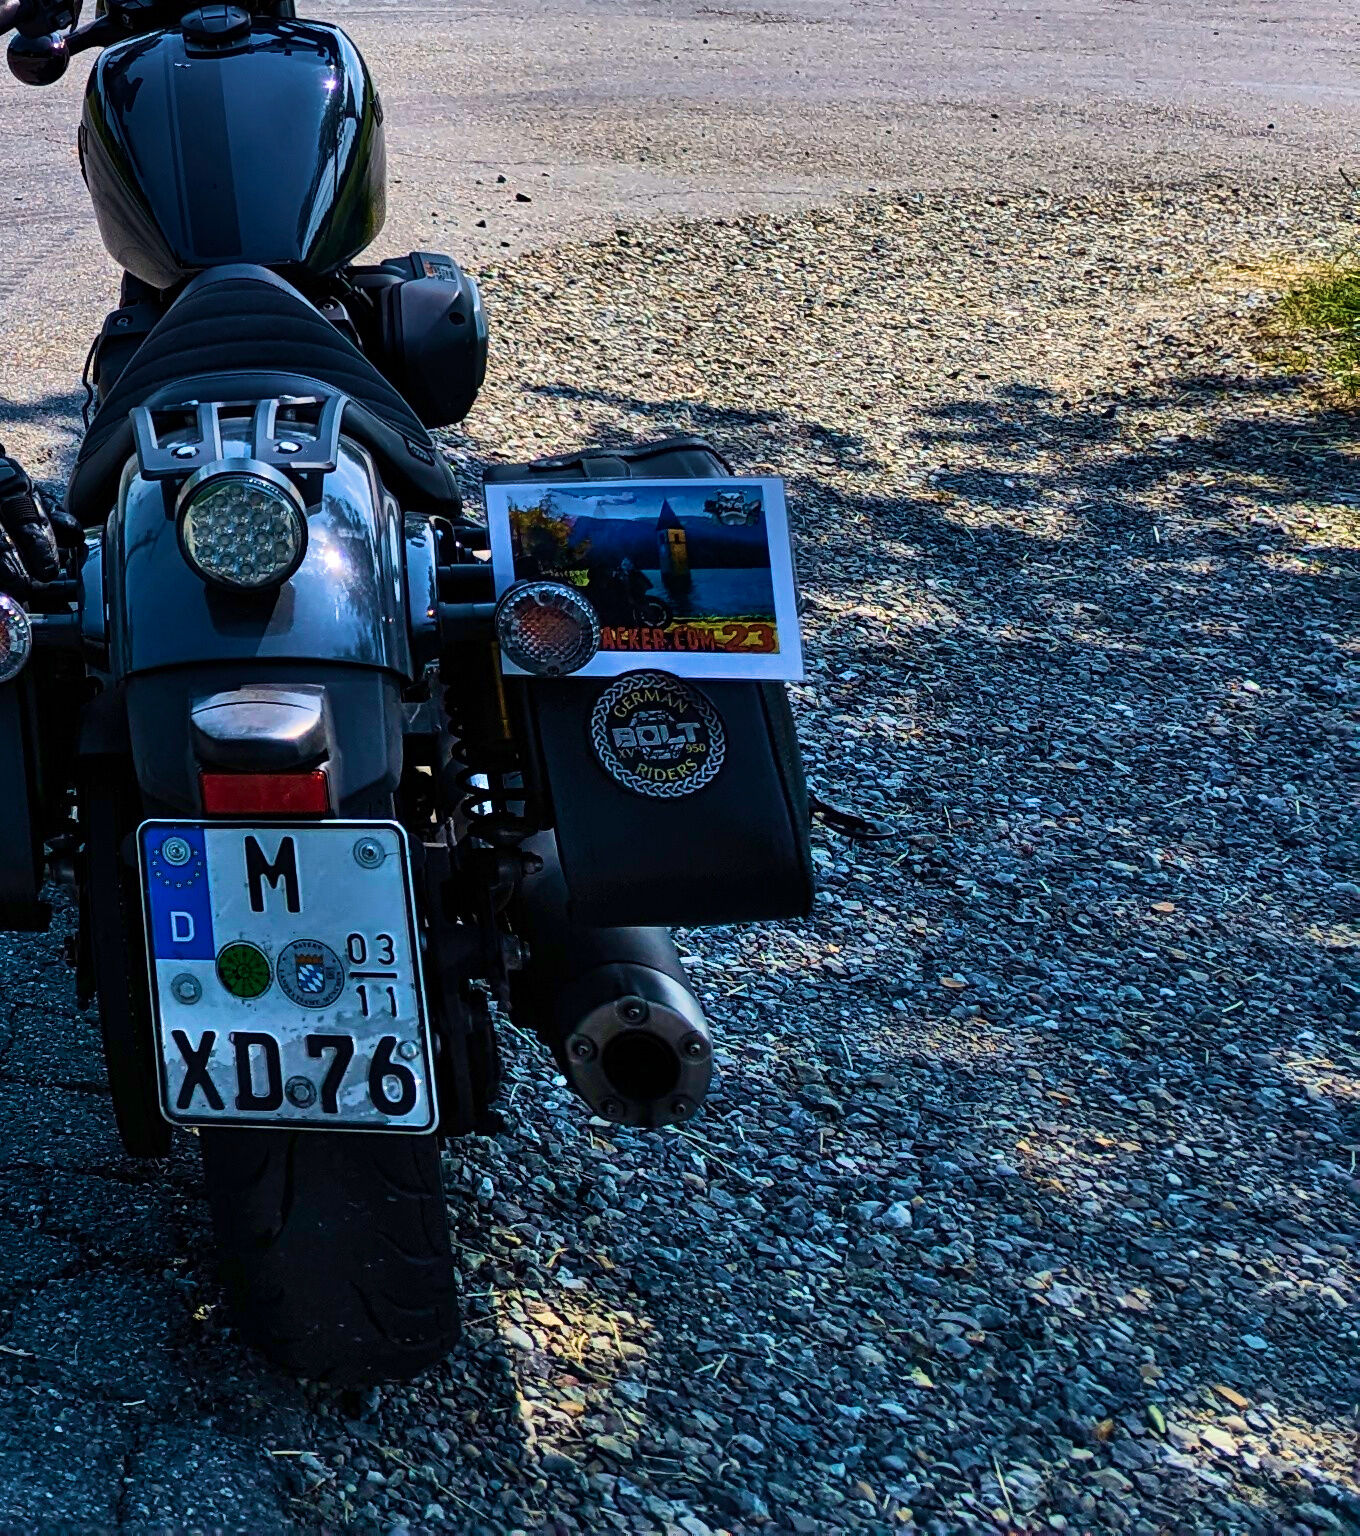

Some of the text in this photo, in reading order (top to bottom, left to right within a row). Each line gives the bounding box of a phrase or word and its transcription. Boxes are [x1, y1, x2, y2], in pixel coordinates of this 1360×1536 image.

[613, 689, 688, 718] GERMAN
[611, 722, 701, 748] BOLT
[685, 743, 706, 754] 950
[618, 747, 635, 759] XV
[634, 758, 698, 781] RIDERS
[244, 835, 301, 913] M
[170, 911, 195, 942] D
[346, 932, 396, 965] 03
[355, 984, 398, 1018] 11
[170, 1029, 418, 1116] XD 76
